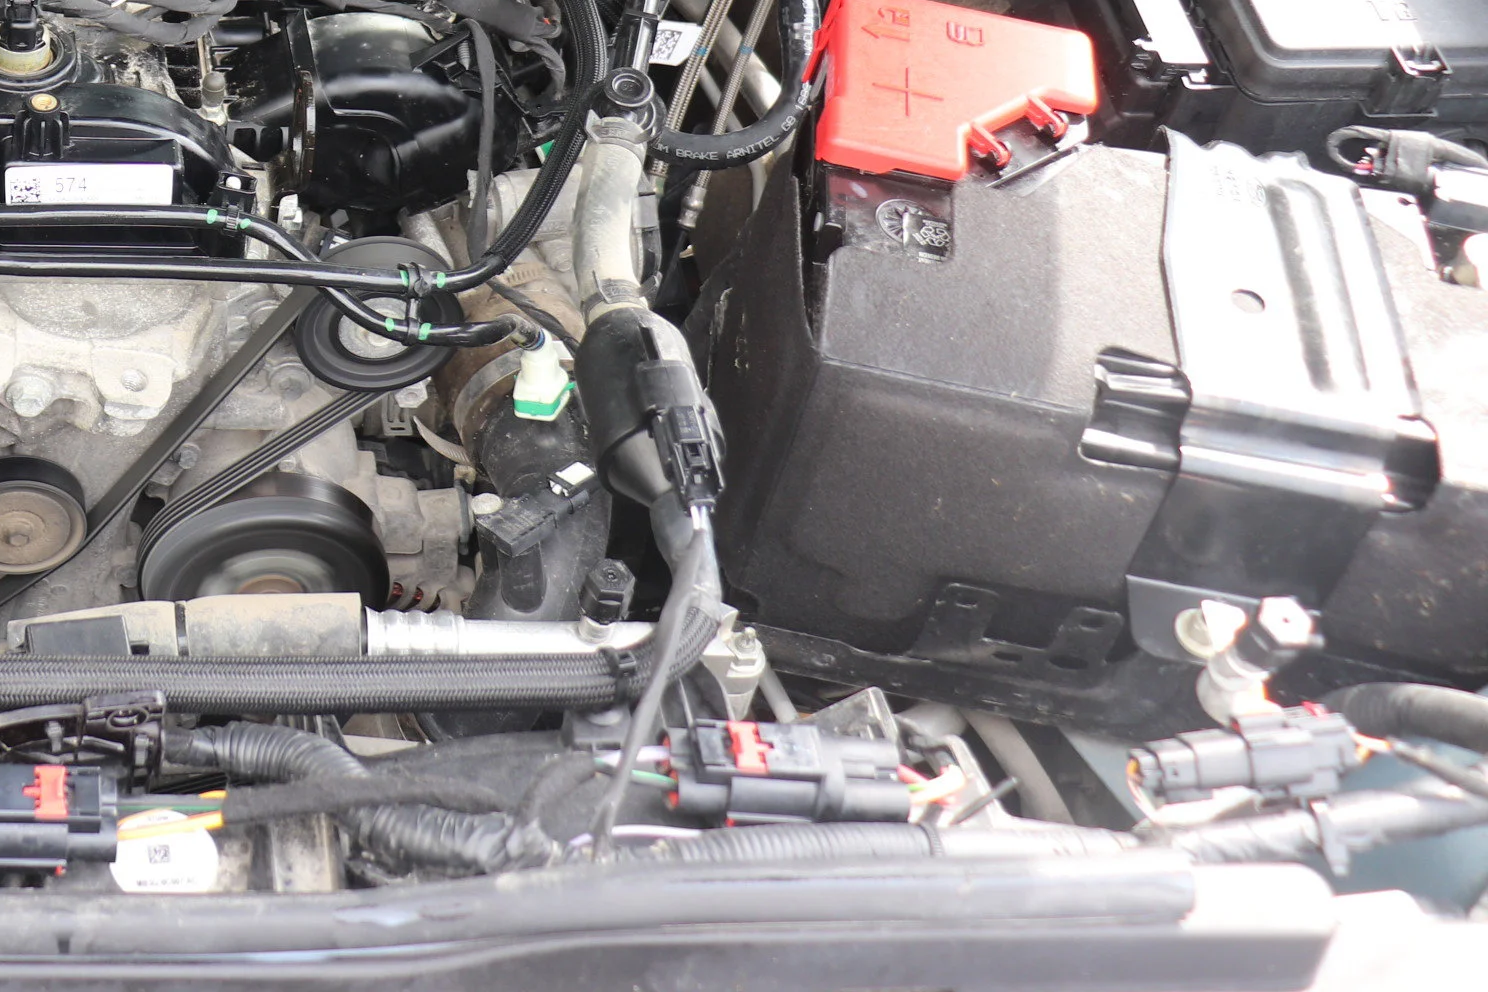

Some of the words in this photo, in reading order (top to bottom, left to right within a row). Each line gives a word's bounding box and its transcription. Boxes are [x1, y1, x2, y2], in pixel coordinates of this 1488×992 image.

[675, 148, 719, 161] BRAKE
[726, 135, 780, 160] ARNITEL
[780, 115, 797, 133] GB
[794, 81, 812, 111] 1689
[55, 177, 87, 193] 574
